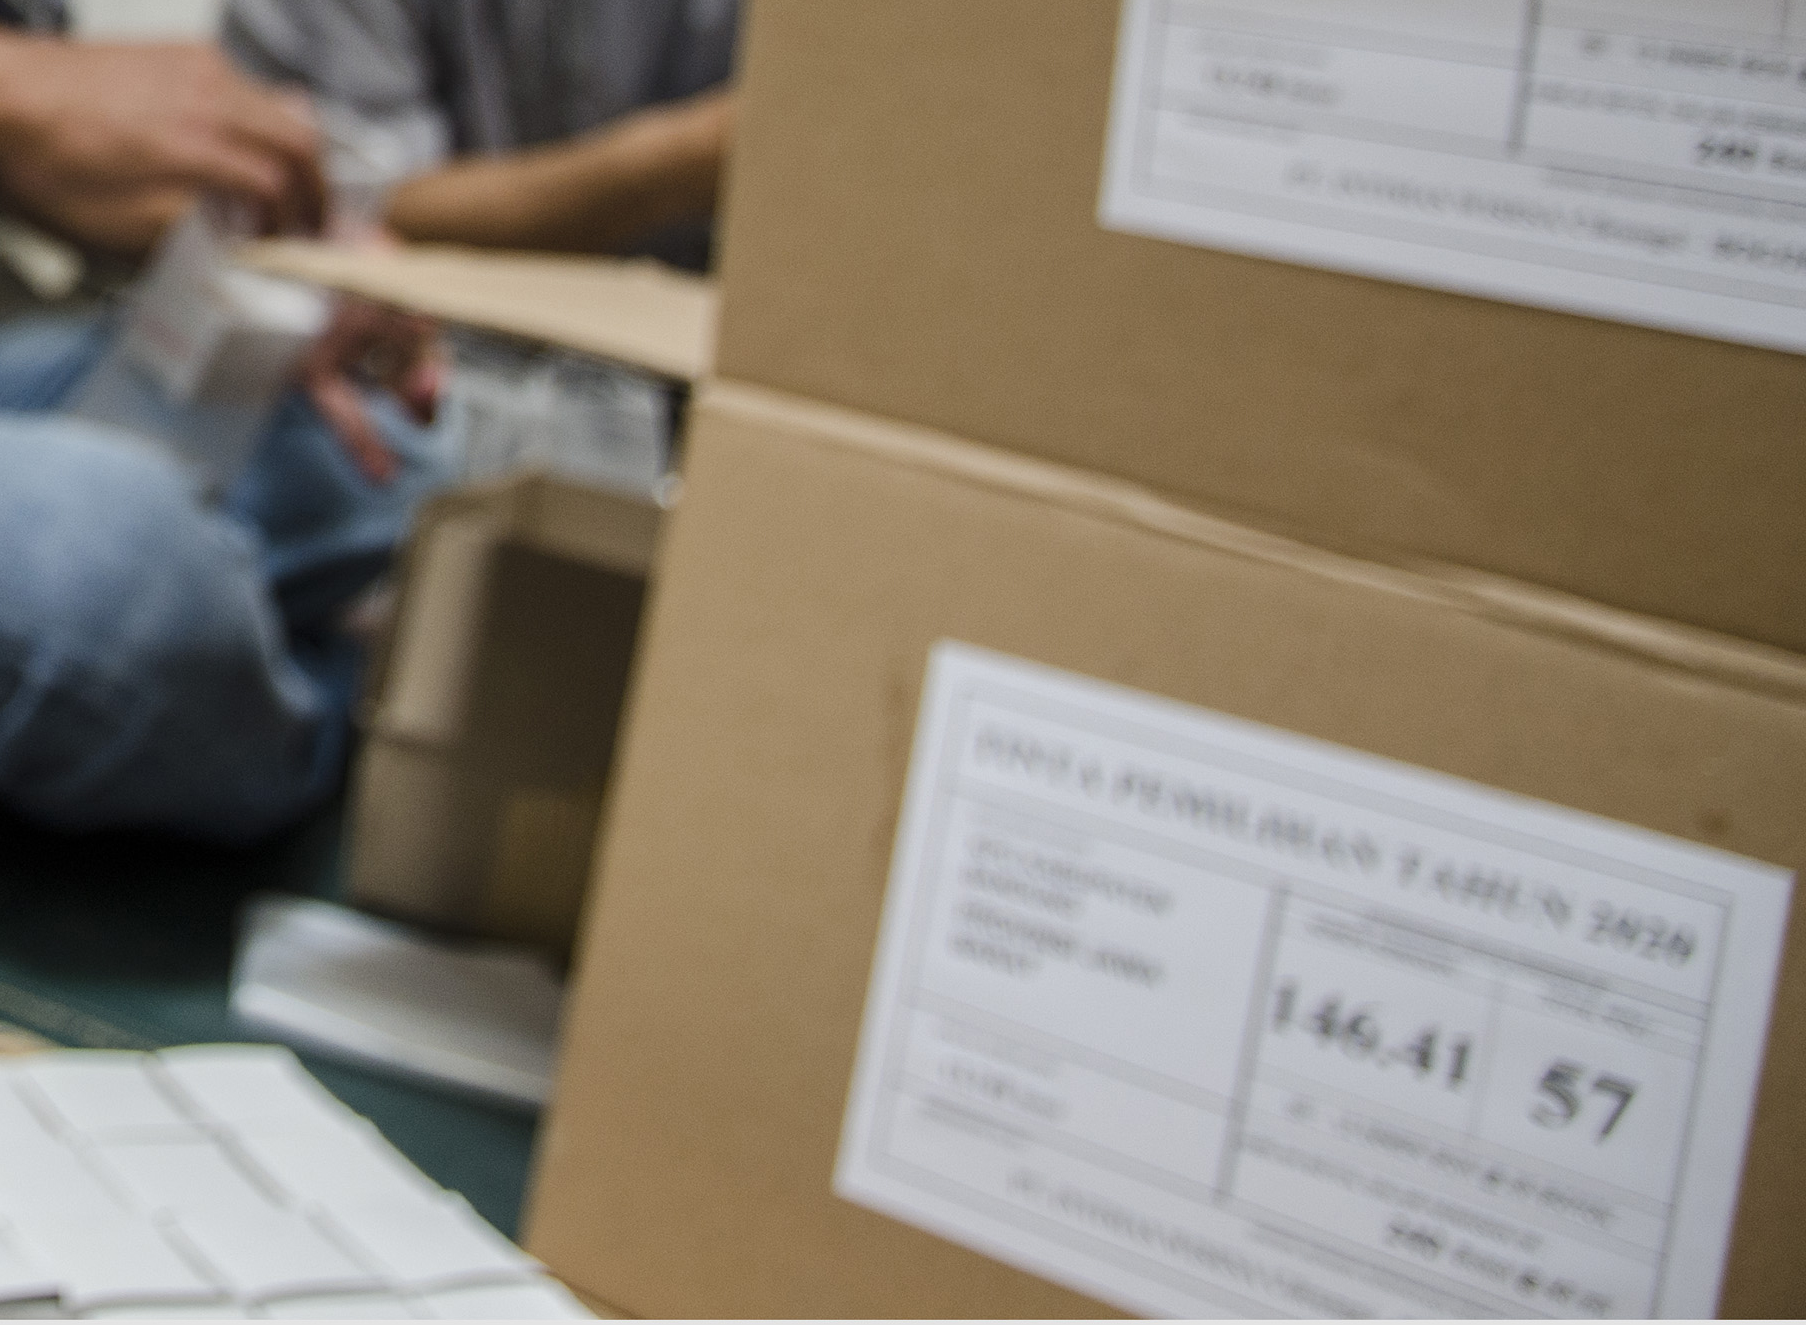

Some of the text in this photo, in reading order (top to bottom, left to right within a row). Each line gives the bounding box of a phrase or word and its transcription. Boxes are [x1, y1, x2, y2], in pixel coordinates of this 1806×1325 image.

[1585, 898, 1697, 969] 2020
[1272, 979, 1638, 1146] 146.41 57
